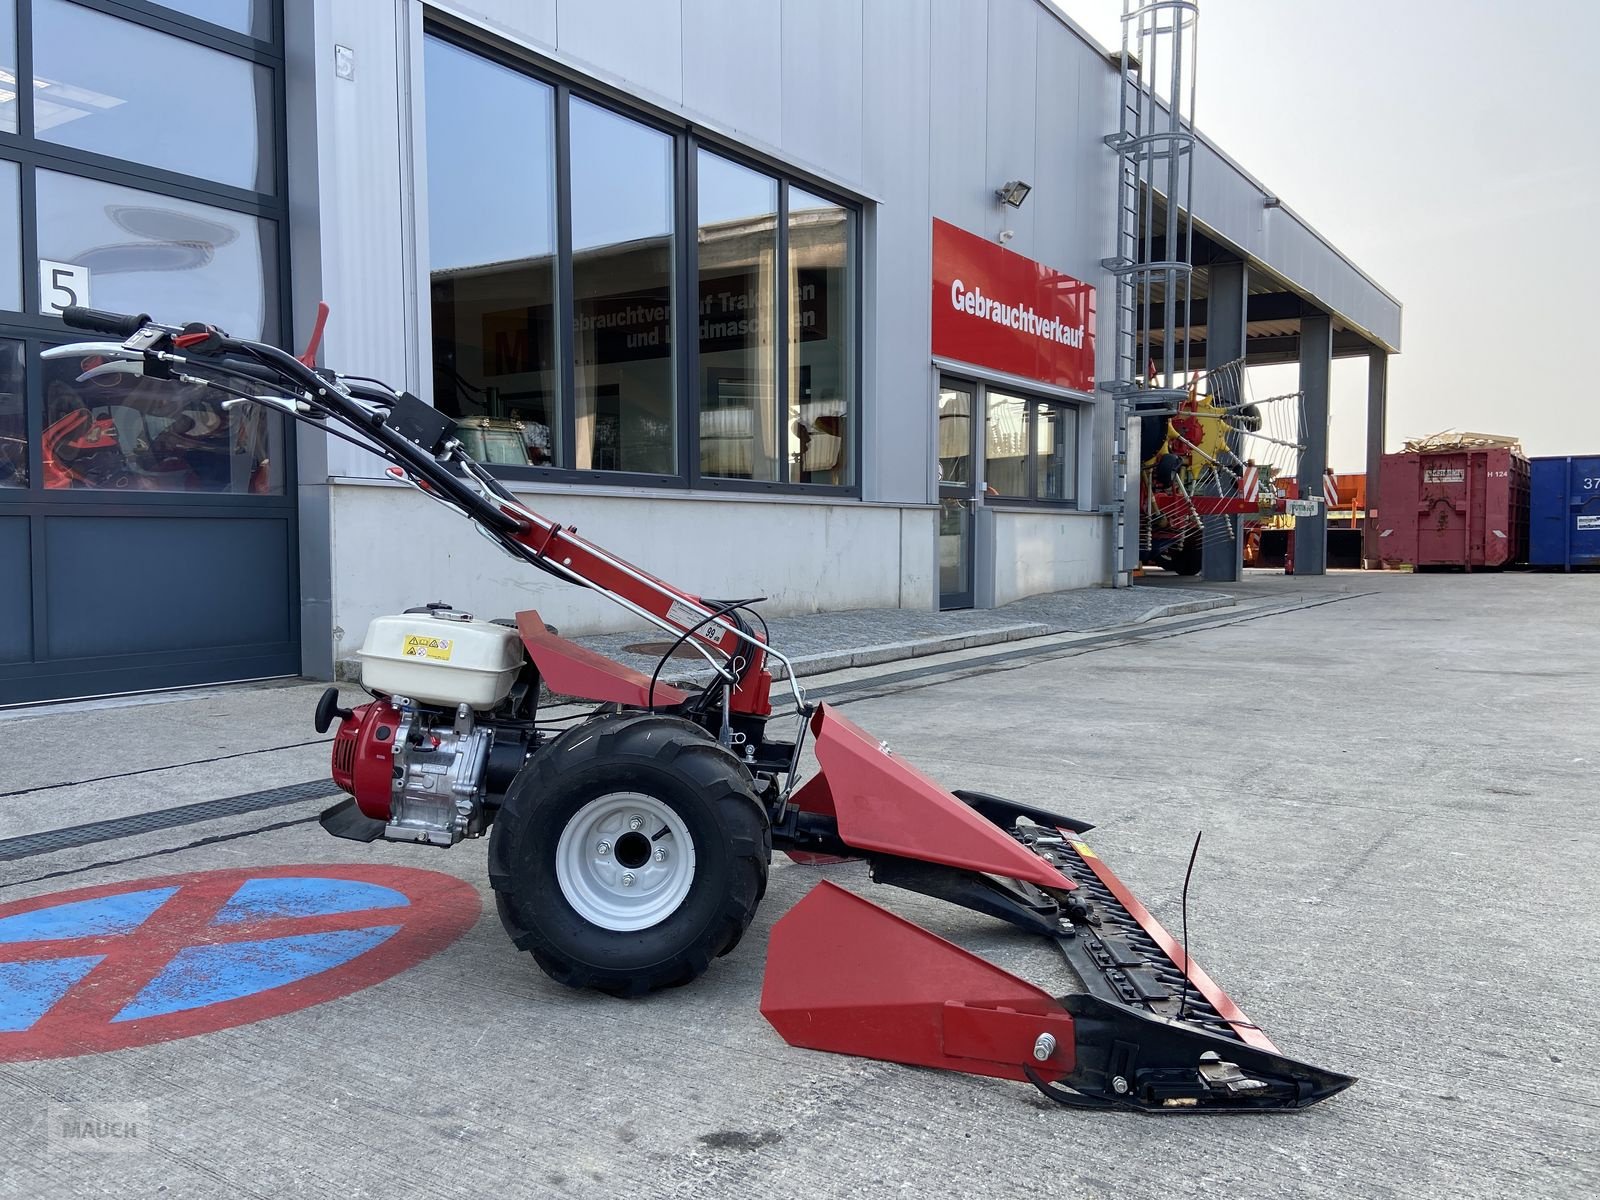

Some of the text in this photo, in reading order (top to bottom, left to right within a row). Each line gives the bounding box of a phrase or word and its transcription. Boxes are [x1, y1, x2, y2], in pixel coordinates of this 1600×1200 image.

[51, 268, 77, 311] 5
[572, 294, 713, 331] ebrauchtverf
[951, 278, 1085, 350] Gebrauchtverkauf
[625, 326, 659, 349] und
[1494, 470, 1508, 478] 124
[705, 626, 716, 639] 99
